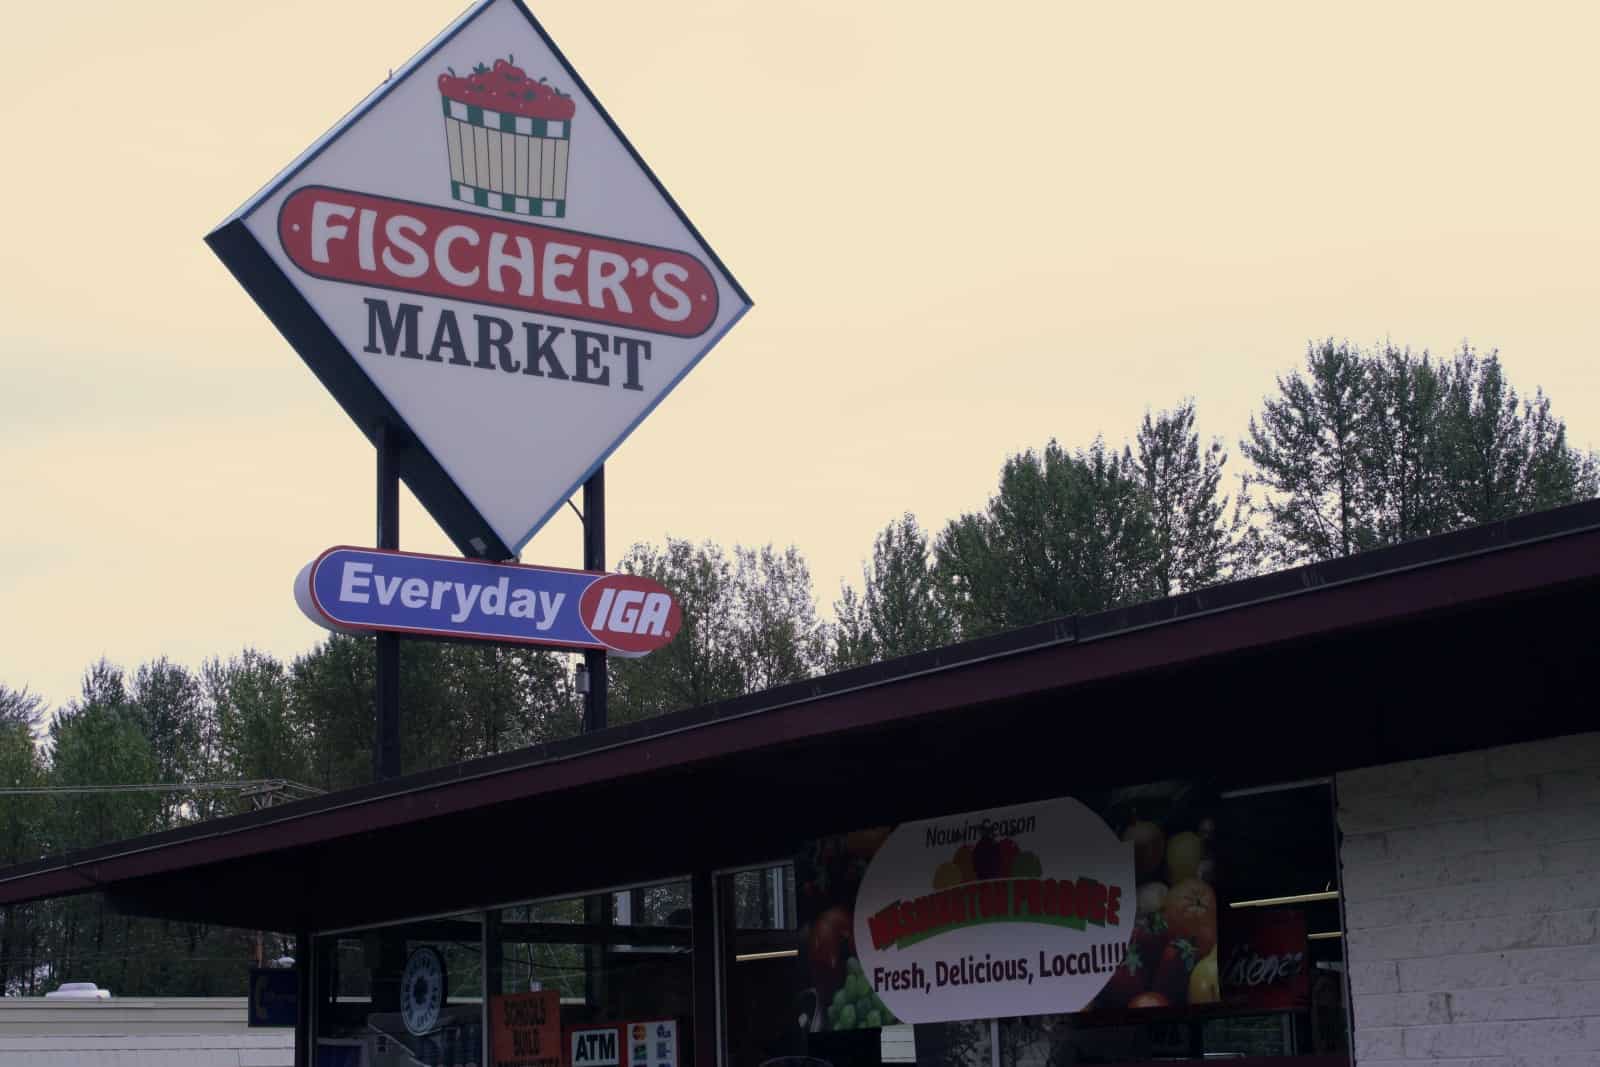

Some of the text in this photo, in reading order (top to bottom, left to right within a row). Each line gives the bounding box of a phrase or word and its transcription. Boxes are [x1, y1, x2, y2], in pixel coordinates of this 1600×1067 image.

[311, 200, 692, 322] FISCHER'S
[363, 298, 652, 392] MARKET
[339, 561, 566, 631] Everyday
[591, 587, 672, 638] IGA
[926, 815, 1036, 848] Now in Season
[1013, 877, 1122, 927] PRODUCE
[873, 962, 931, 994] Fresh,
[935, 953, 1034, 984] Delicious,
[575, 1033, 616, 1062] ATM
